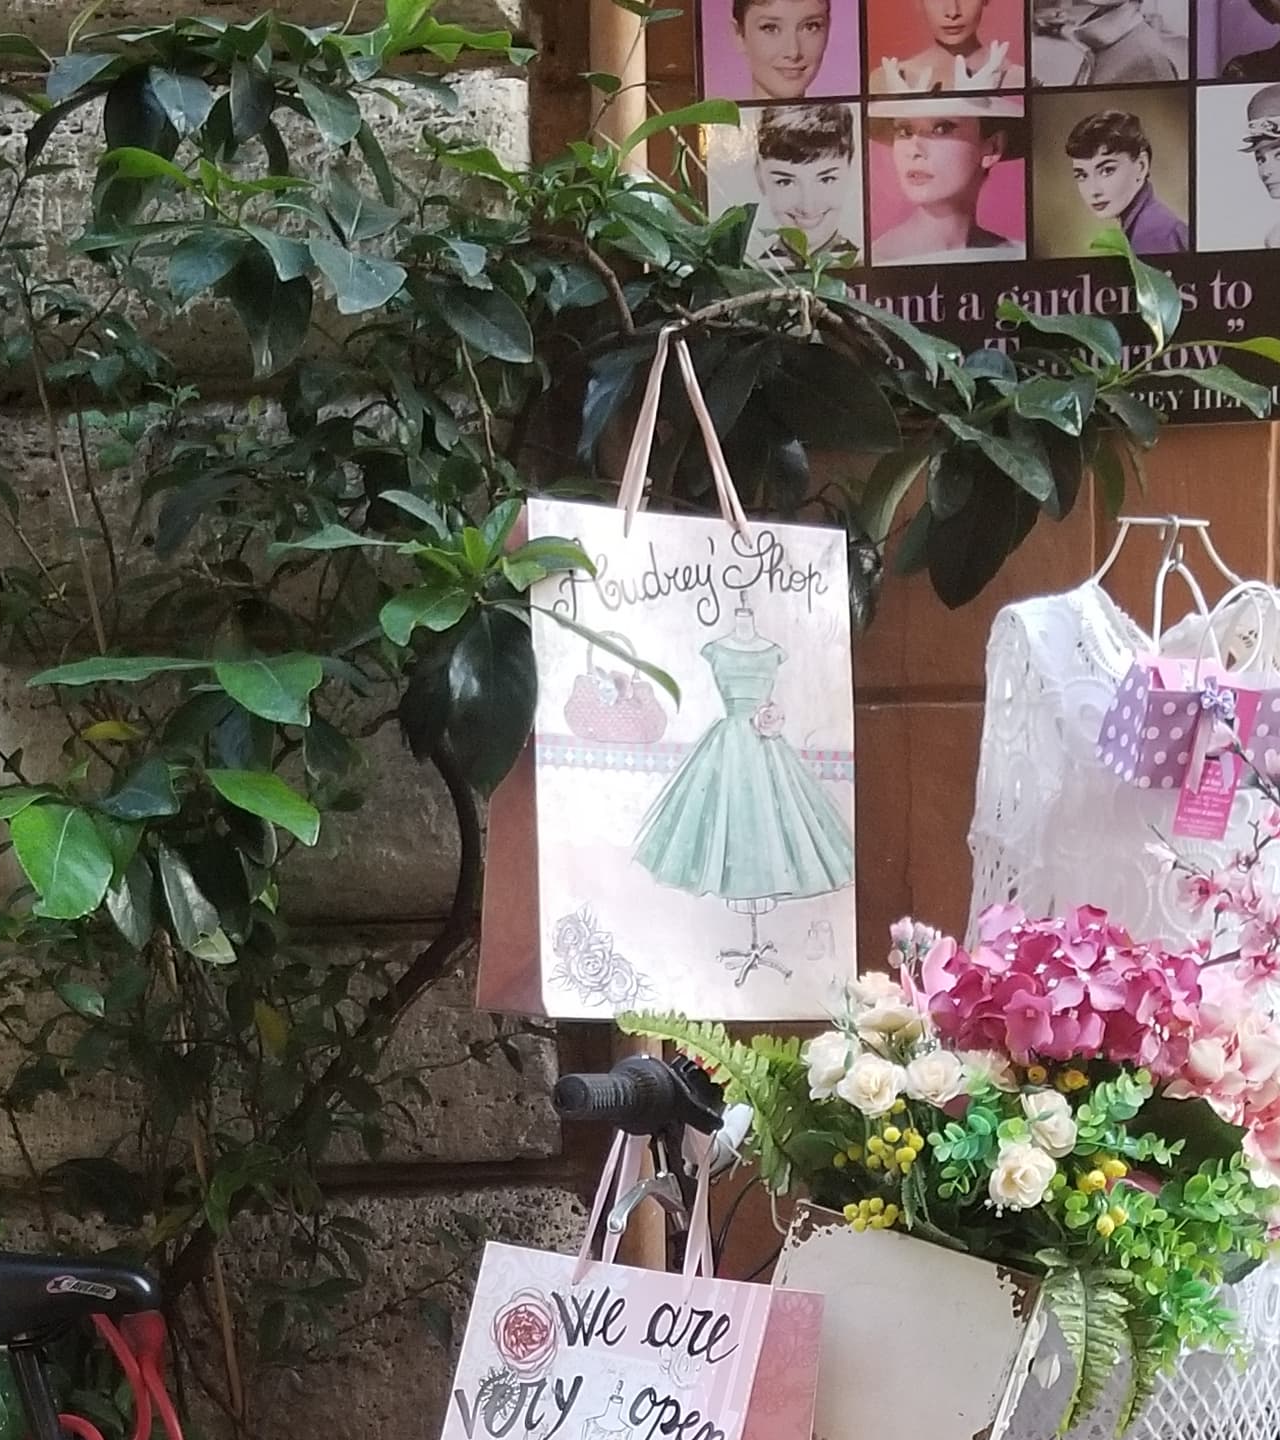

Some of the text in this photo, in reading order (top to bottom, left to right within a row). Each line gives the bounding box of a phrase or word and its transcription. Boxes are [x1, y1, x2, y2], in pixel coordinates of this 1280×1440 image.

[958, 292, 984, 321] a
[1209, 269, 1253, 311] to
[551, 1286, 739, 1364] We are
